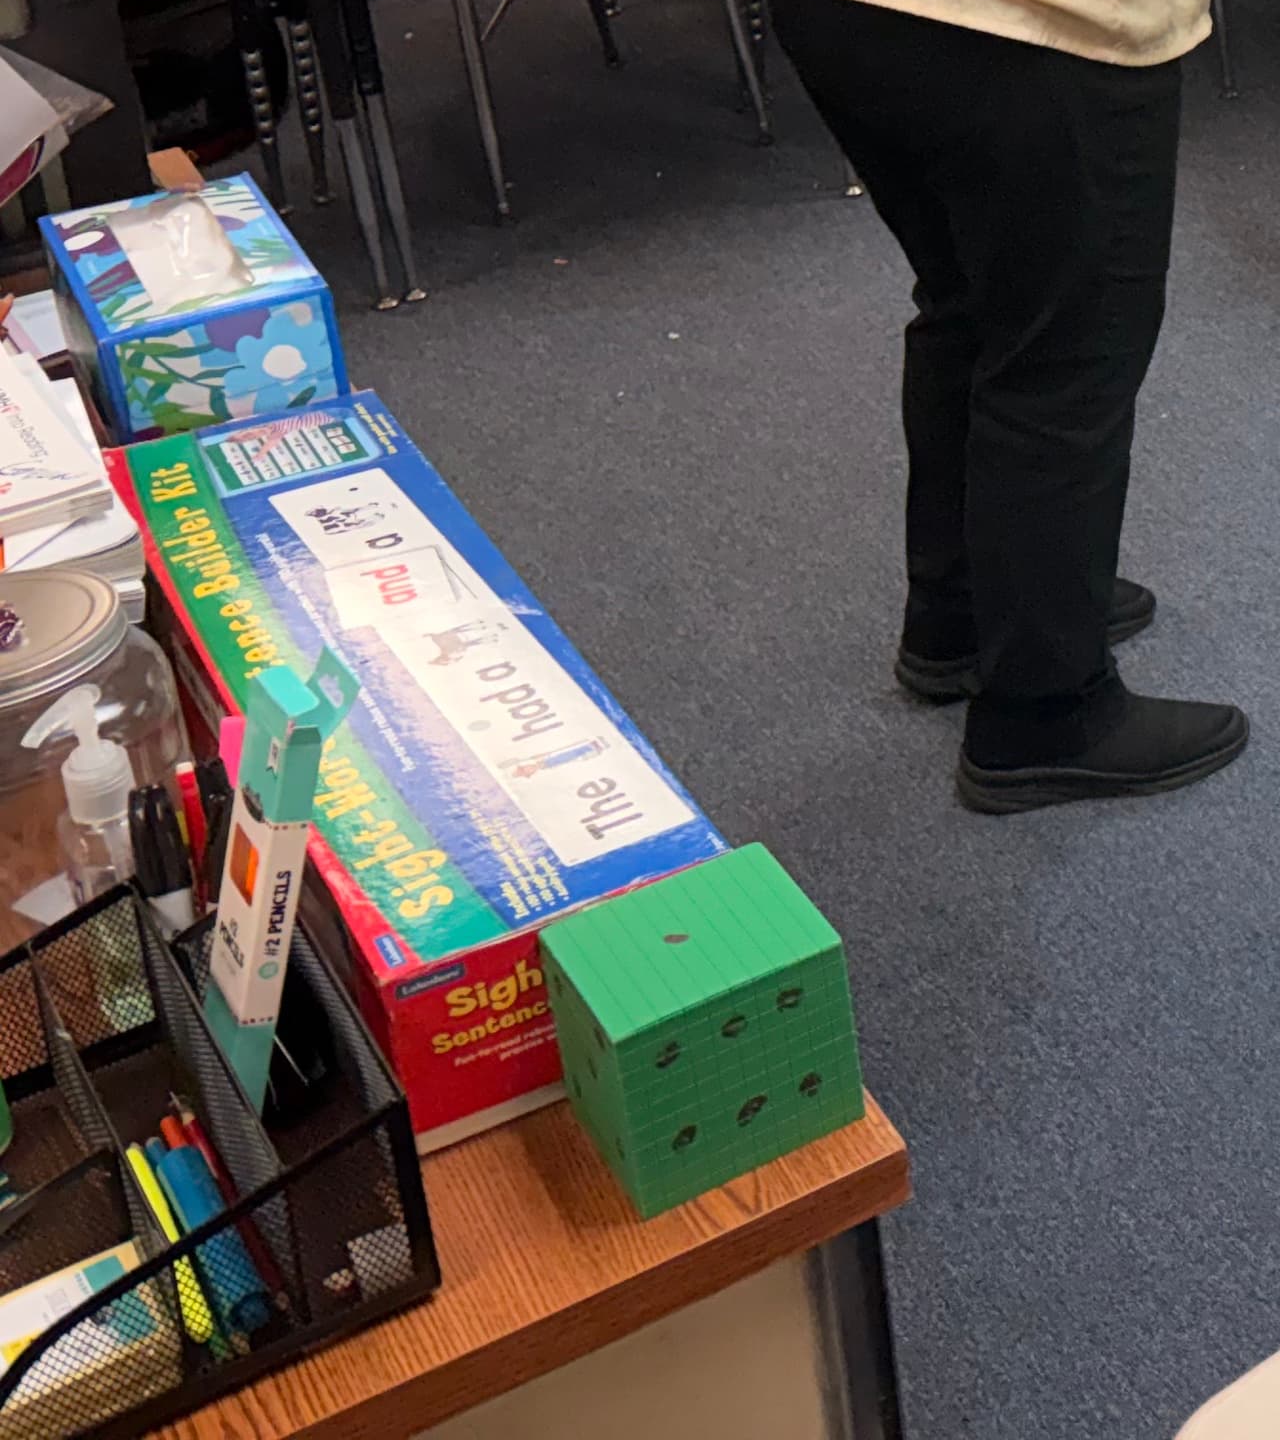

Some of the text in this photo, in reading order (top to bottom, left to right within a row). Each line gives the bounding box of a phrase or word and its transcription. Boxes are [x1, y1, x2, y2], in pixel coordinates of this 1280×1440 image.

[365, 532, 404, 550] a
[360, 563, 419, 605] and
[150, 462, 454, 920] Sight-Wor Builder Kit
[475, 660, 518, 682] a
[479, 682, 565, 742] had
[576, 776, 644, 842] The
[266, 869, 293, 936] PENCILS
[445, 959, 544, 1018] Sigh
[431, 1002, 548, 1055] Sentenc
